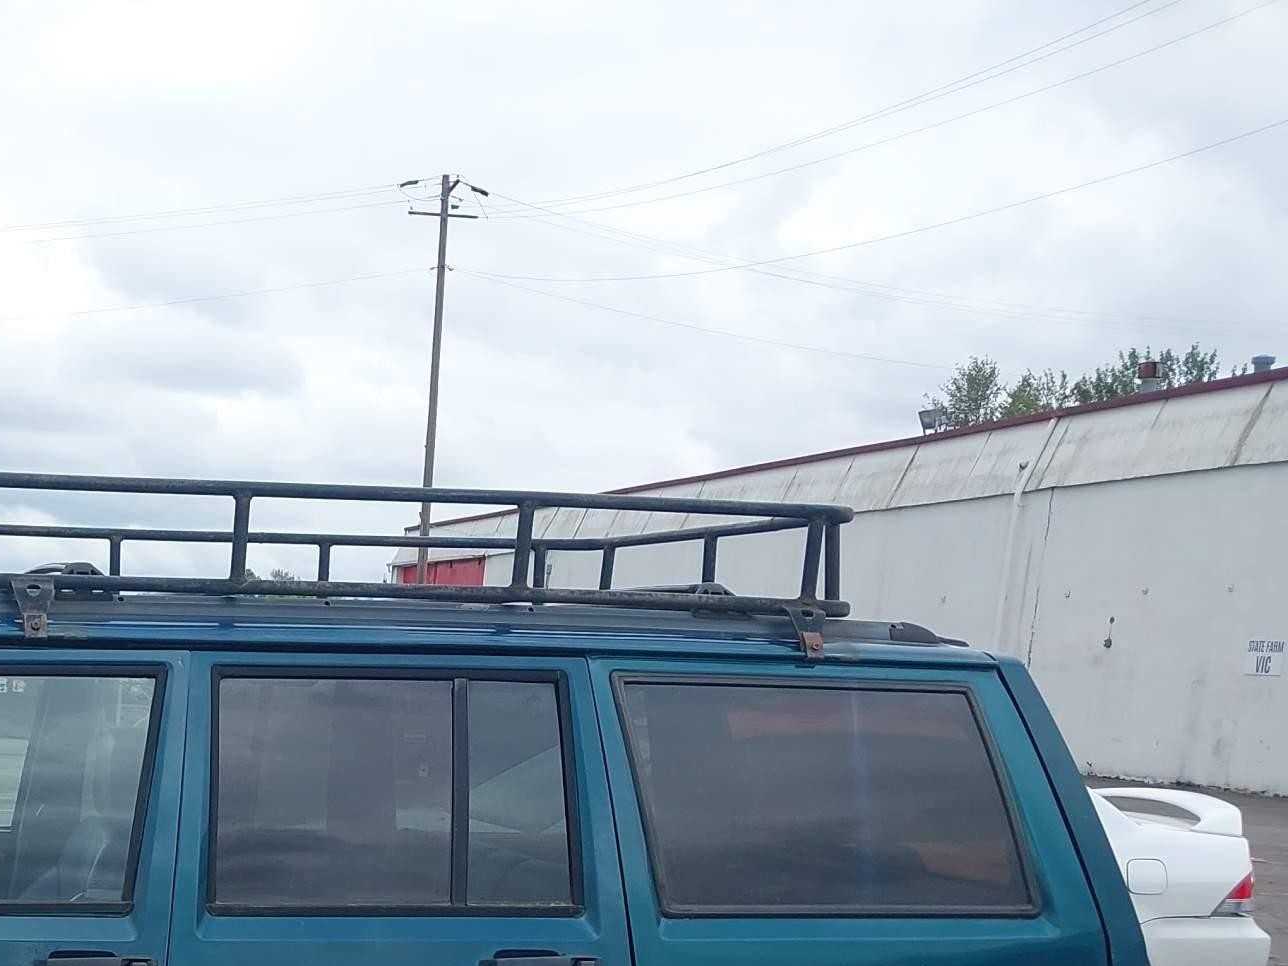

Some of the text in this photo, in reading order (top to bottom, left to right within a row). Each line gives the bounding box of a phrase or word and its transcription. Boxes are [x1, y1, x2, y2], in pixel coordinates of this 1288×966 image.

[1247, 640, 1285, 653] STATE FARM
[1255, 655, 1271, 673] VIC
